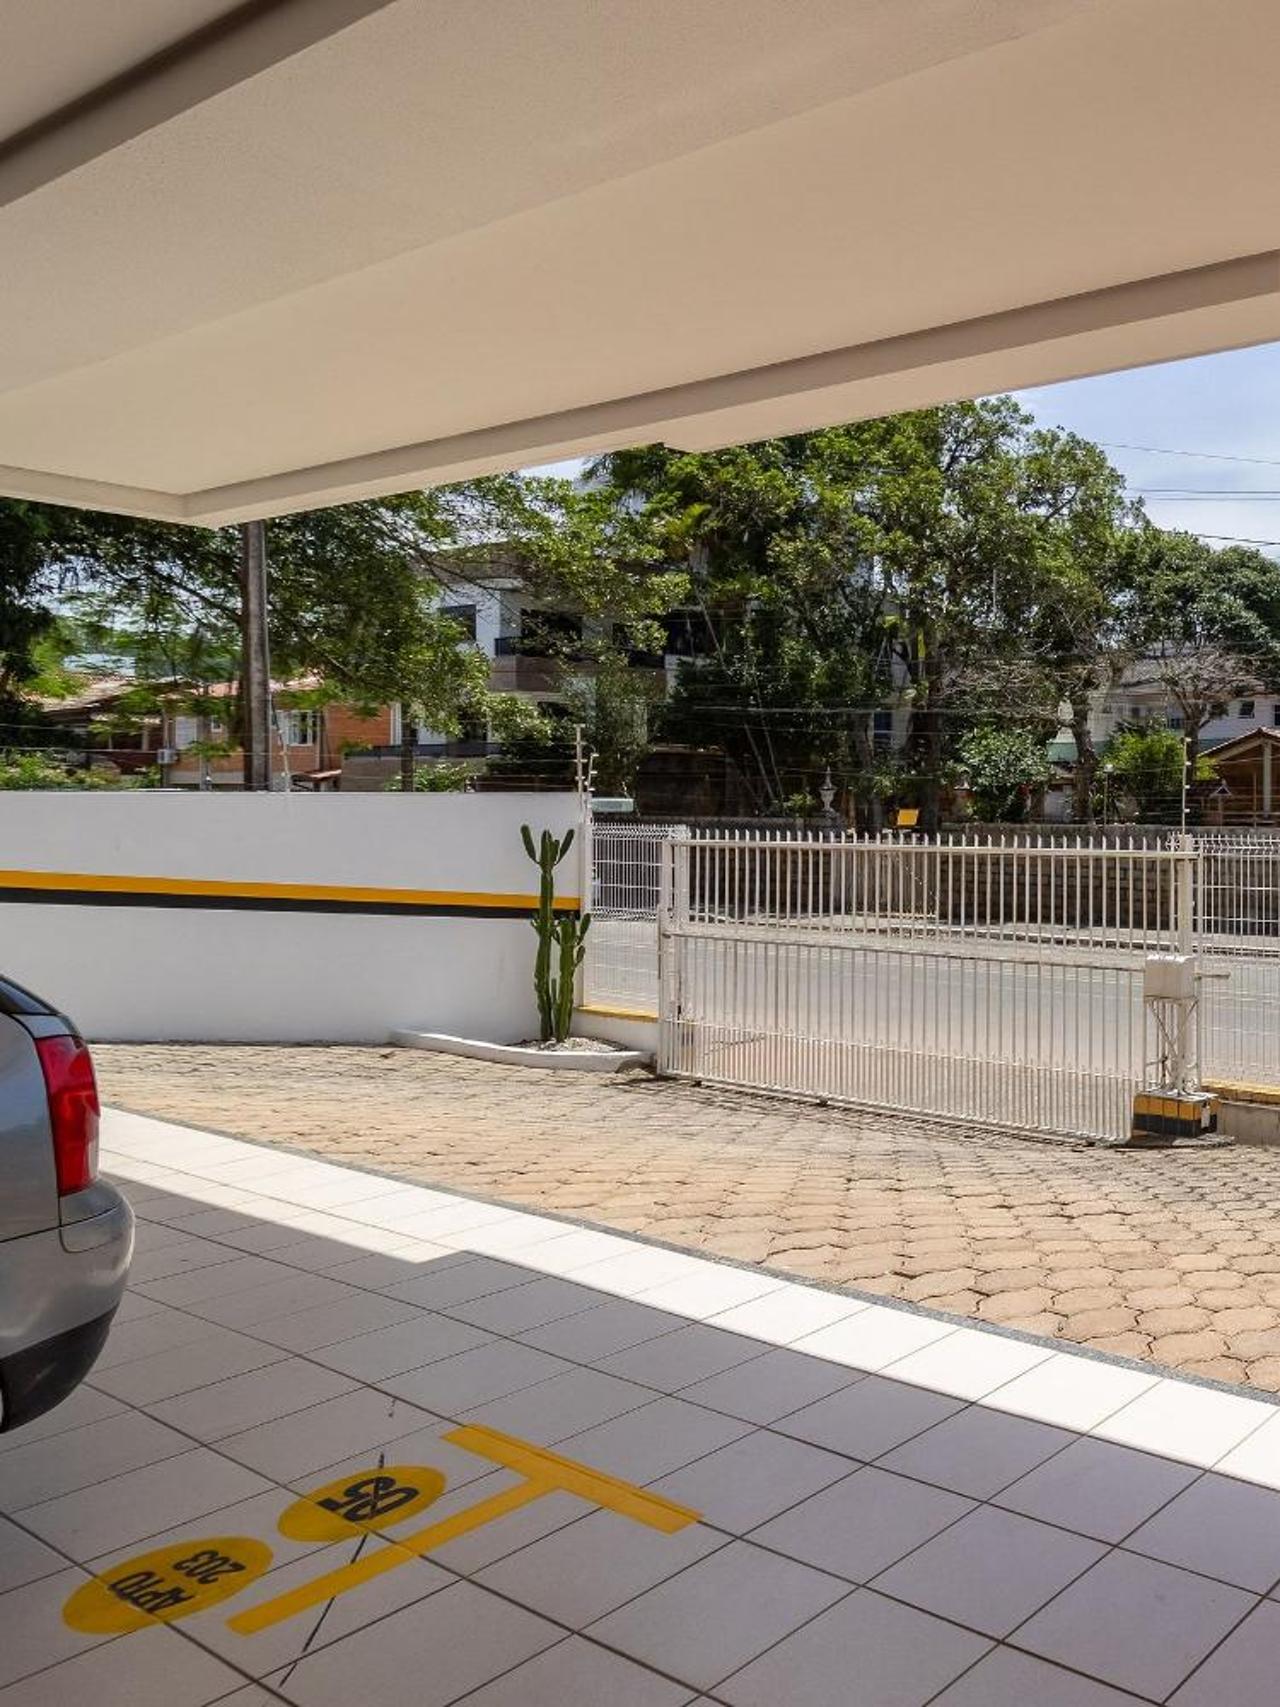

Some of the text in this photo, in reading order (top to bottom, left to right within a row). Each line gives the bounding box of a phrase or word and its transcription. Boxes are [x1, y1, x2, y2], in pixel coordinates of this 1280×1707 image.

[315, 1476, 419, 1522] 05
[173, 1549, 246, 1584] 203
[108, 1571, 194, 1613] APTO
